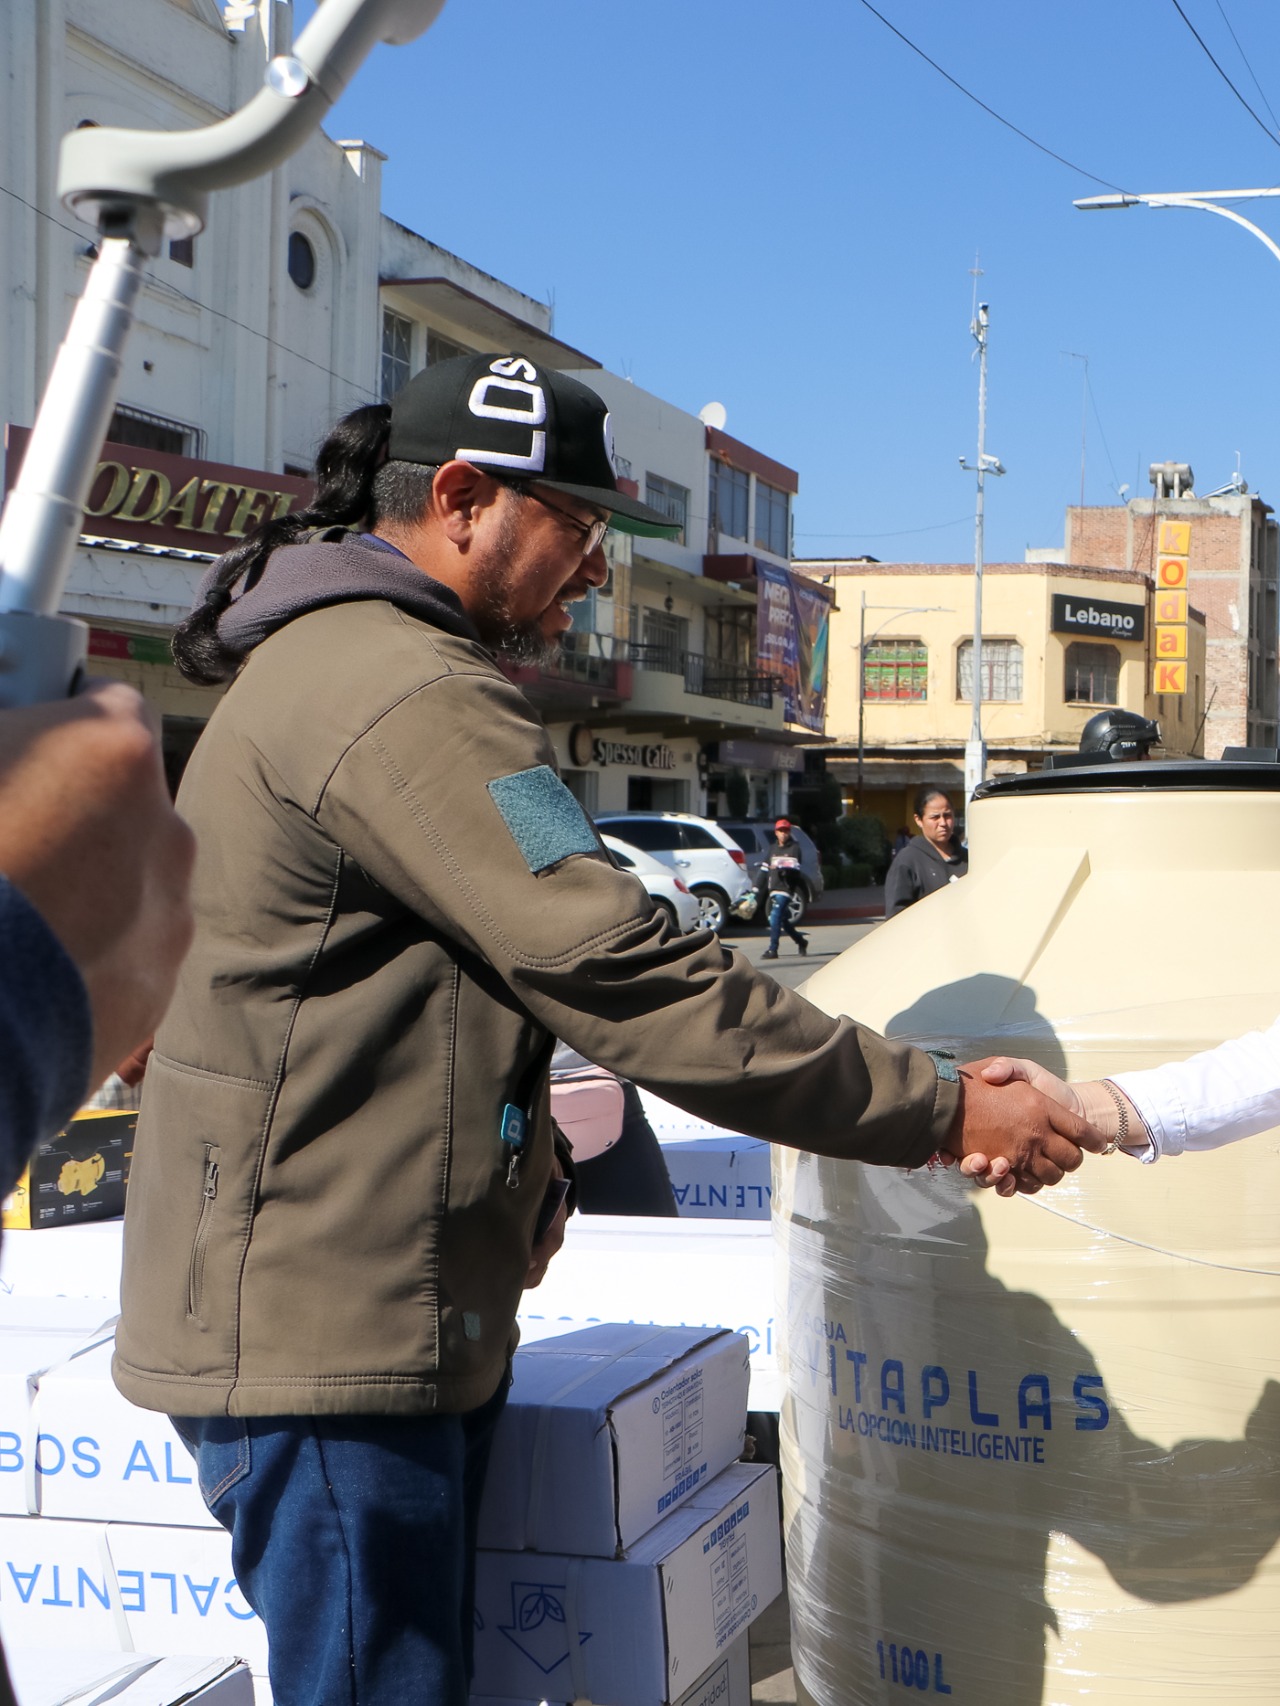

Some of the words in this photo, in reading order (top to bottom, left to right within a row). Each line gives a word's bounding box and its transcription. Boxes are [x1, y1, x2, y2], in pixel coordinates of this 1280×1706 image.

[1064, 604, 1135, 630] Lebano
[597, 738, 642, 766] Spesso
[805, 1338, 1110, 1432] VITAPLAS
[0, 1430, 102, 1479] BOS
[122, 1439, 193, 1485] AL
[838, 1404, 856, 1433] LA
[857, 1411, 917, 1449] OPCION
[920, 1424, 1046, 1464] INTELIGENTE
[6, 1560, 258, 1622] CALENTA
[876, 1640, 930, 1691] 1100
[934, 1652, 952, 1695] L
